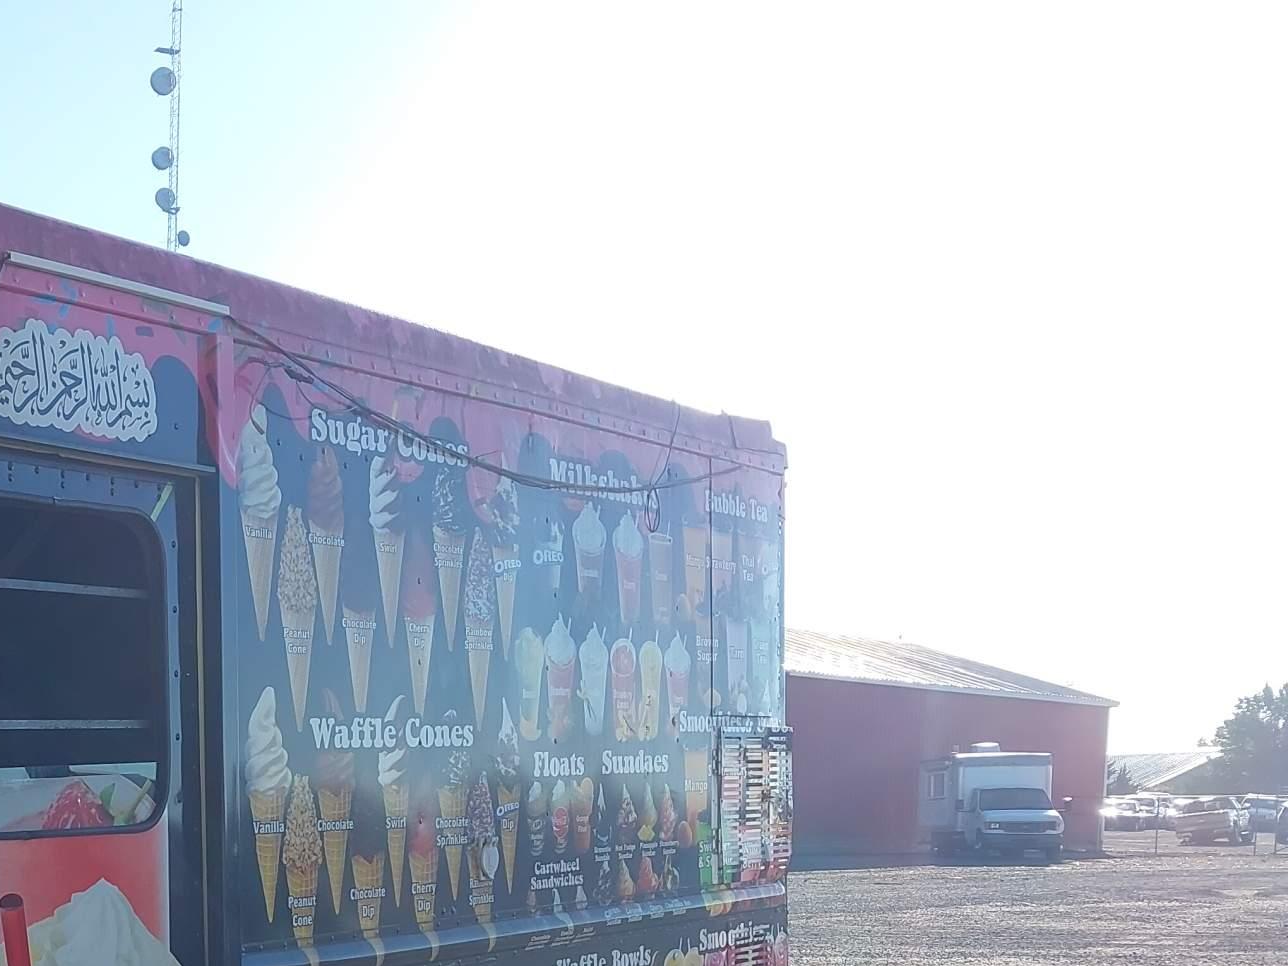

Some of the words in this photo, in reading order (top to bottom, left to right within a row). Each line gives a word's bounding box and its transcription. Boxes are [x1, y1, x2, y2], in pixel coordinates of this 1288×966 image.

[311, 408, 390, 457] Sugar
[749, 498, 769, 523] Tea
[245, 526, 274, 541] Vanilla
[308, 531, 346, 548] Chocolate
[379, 542, 398, 554] Swirl
[433, 541, 465, 556] Chocolate
[434, 557, 464, 571] Sprinkles
[533, 549, 565, 565] OREO
[342, 617, 377, 631] Chocolate
[283, 626, 310, 641] Peanut
[354, 632, 367, 647] Dip
[287, 642, 308, 656] Cone
[464, 639, 495, 652] Sprinkles
[310, 717, 397, 750] Waffle
[405, 716, 475, 748] Cones
[533, 751, 586, 778] Floats
[601, 749, 670, 776] Sundaes
[684, 780, 708, 794] Mango
[496, 801, 520, 817] OREO
[253, 821, 285, 834] Vanilla
[317, 818, 354, 832] Chocolate
[385, 817, 407, 829] Swirl
[435, 816, 470, 830] Chocolate
[502, 819, 515, 832] Dip
[436, 833, 469, 848] Sprinkles
[534, 858, 581, 875] Cartwheel
[530, 873, 585, 891] Sandwiches
[350, 887, 387, 901] Chocolate
[411, 882, 438, 898] Cherry
[287, 895, 317, 911] Peanut
[417, 899, 432, 914] Dip
[362, 905, 376, 920] Dip
[292, 914, 314, 927] Cone
